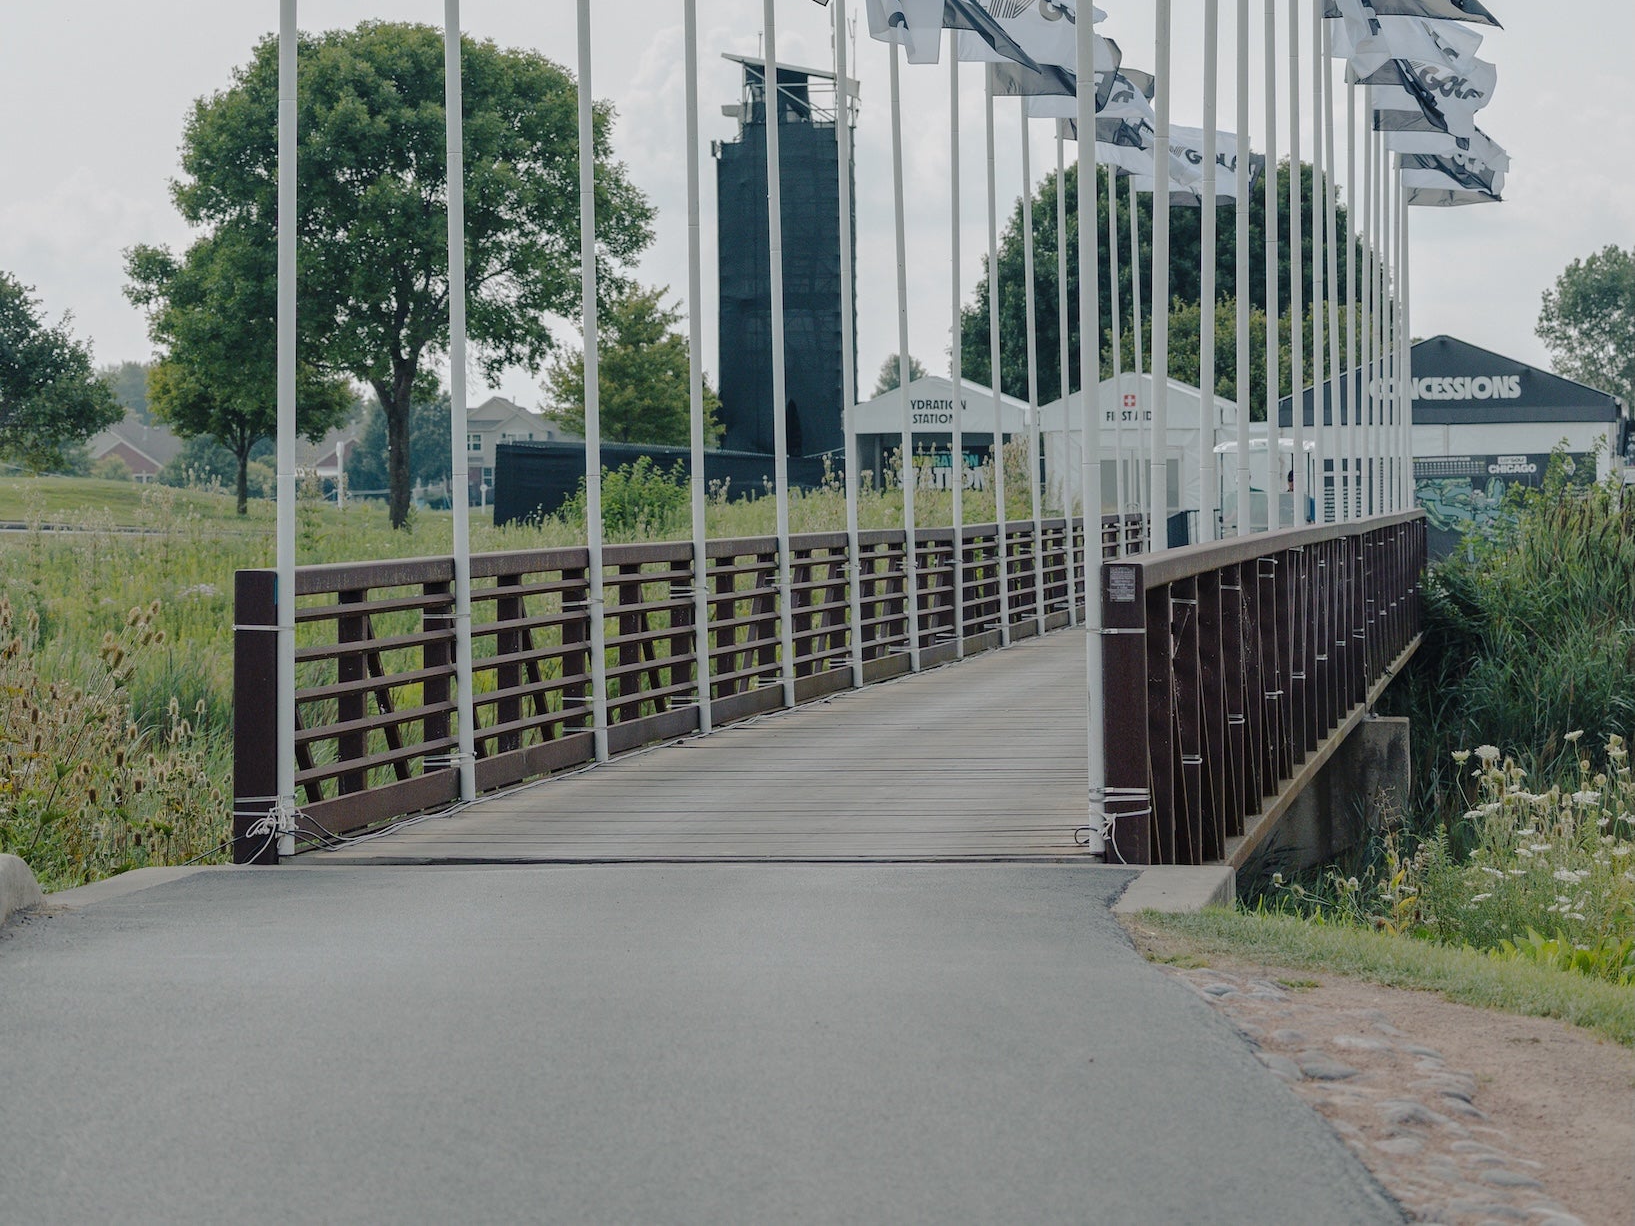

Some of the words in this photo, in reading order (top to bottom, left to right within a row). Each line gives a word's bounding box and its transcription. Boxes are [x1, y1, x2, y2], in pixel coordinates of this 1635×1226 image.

[1419, 66, 1485, 100] GOLF
[910, 400, 967, 410] YDRATIN
[1106, 411, 1132, 421] FIST
[1488, 464, 1537, 474] CHICAGO
